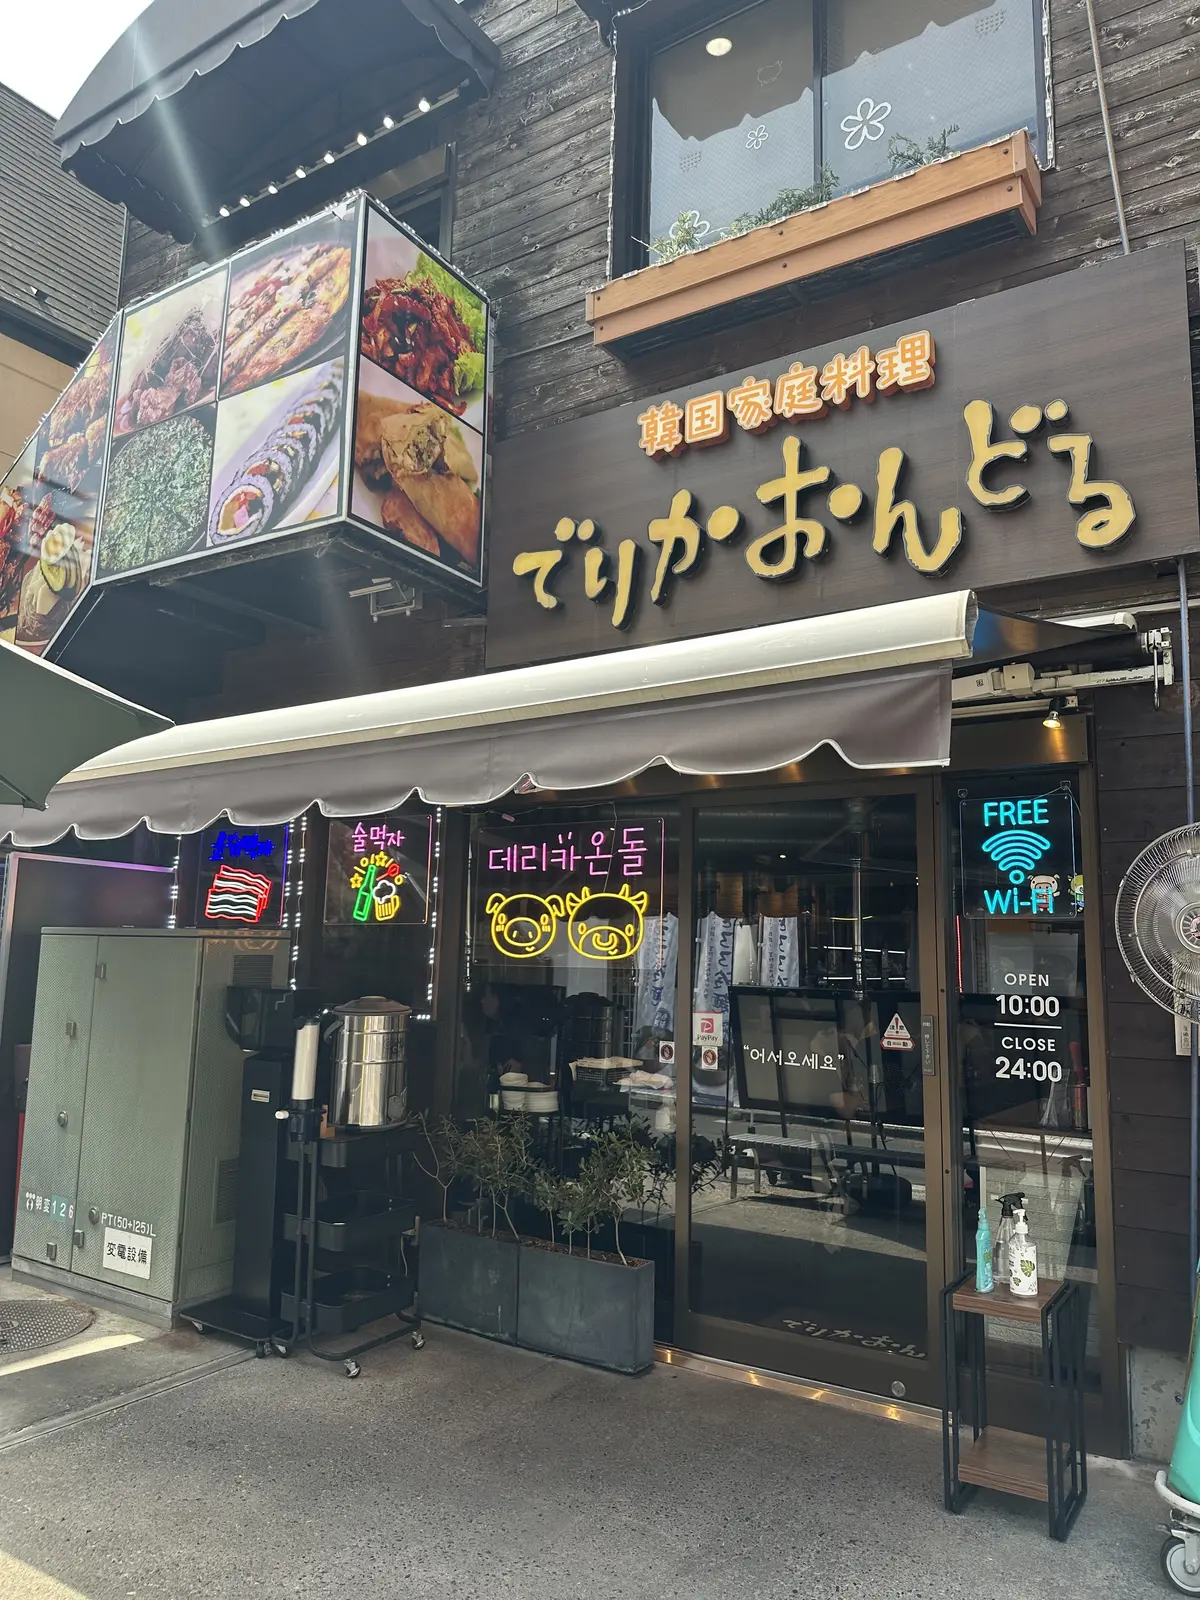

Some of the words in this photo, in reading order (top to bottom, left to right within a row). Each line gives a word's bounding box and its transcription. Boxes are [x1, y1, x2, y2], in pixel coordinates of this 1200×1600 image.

[637, 330, 936, 457] 韓国家庭料理
[983, 799, 1049, 826] FREE
[351, 821, 406, 852] 술먹자
[983, 887, 1053, 914] Wi-Fi
[1004, 973, 1050, 987] OPEN
[995, 994, 1060, 1017] 10:00
[696, 1034, 719, 1043] PayPay
[1001, 1036, 1056, 1052] CLOSE
[995, 1056, 1063, 1082] 24:00
[106, 1242, 148, 1265] 変電設備
